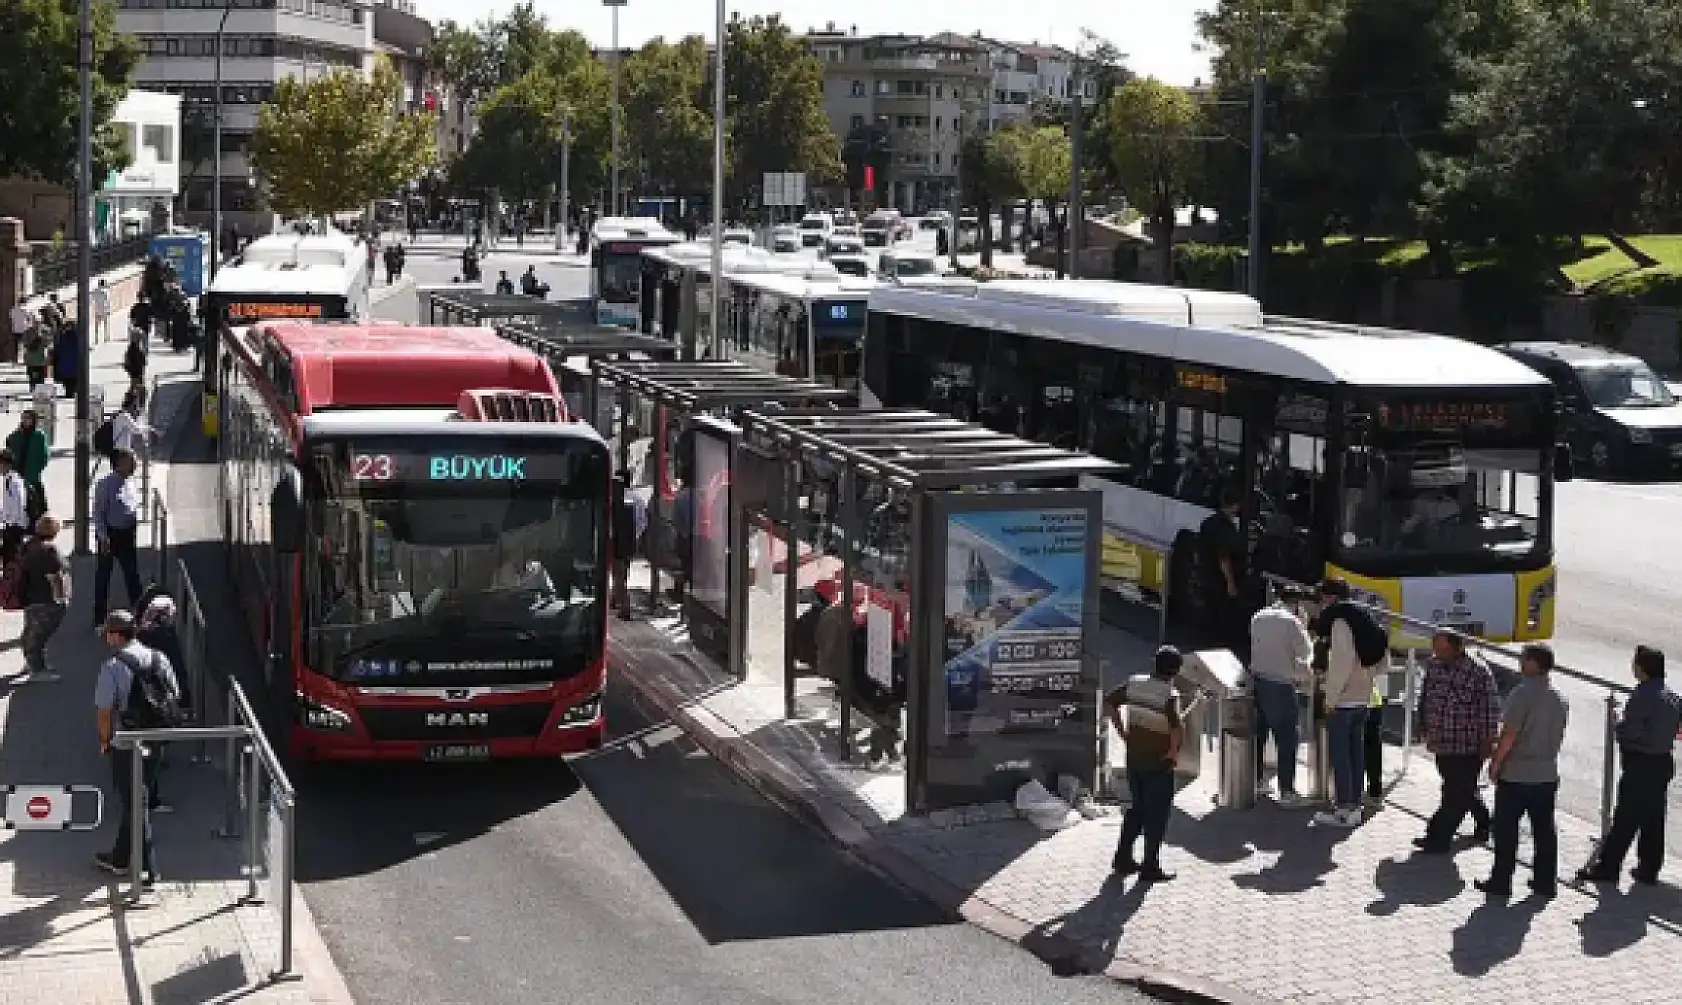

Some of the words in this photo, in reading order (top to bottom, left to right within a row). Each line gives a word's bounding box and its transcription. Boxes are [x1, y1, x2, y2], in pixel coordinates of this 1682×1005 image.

[353, 454, 392, 480] 23
[430, 453, 527, 480] BÜYÜK
[427, 712, 489, 726] MAN
